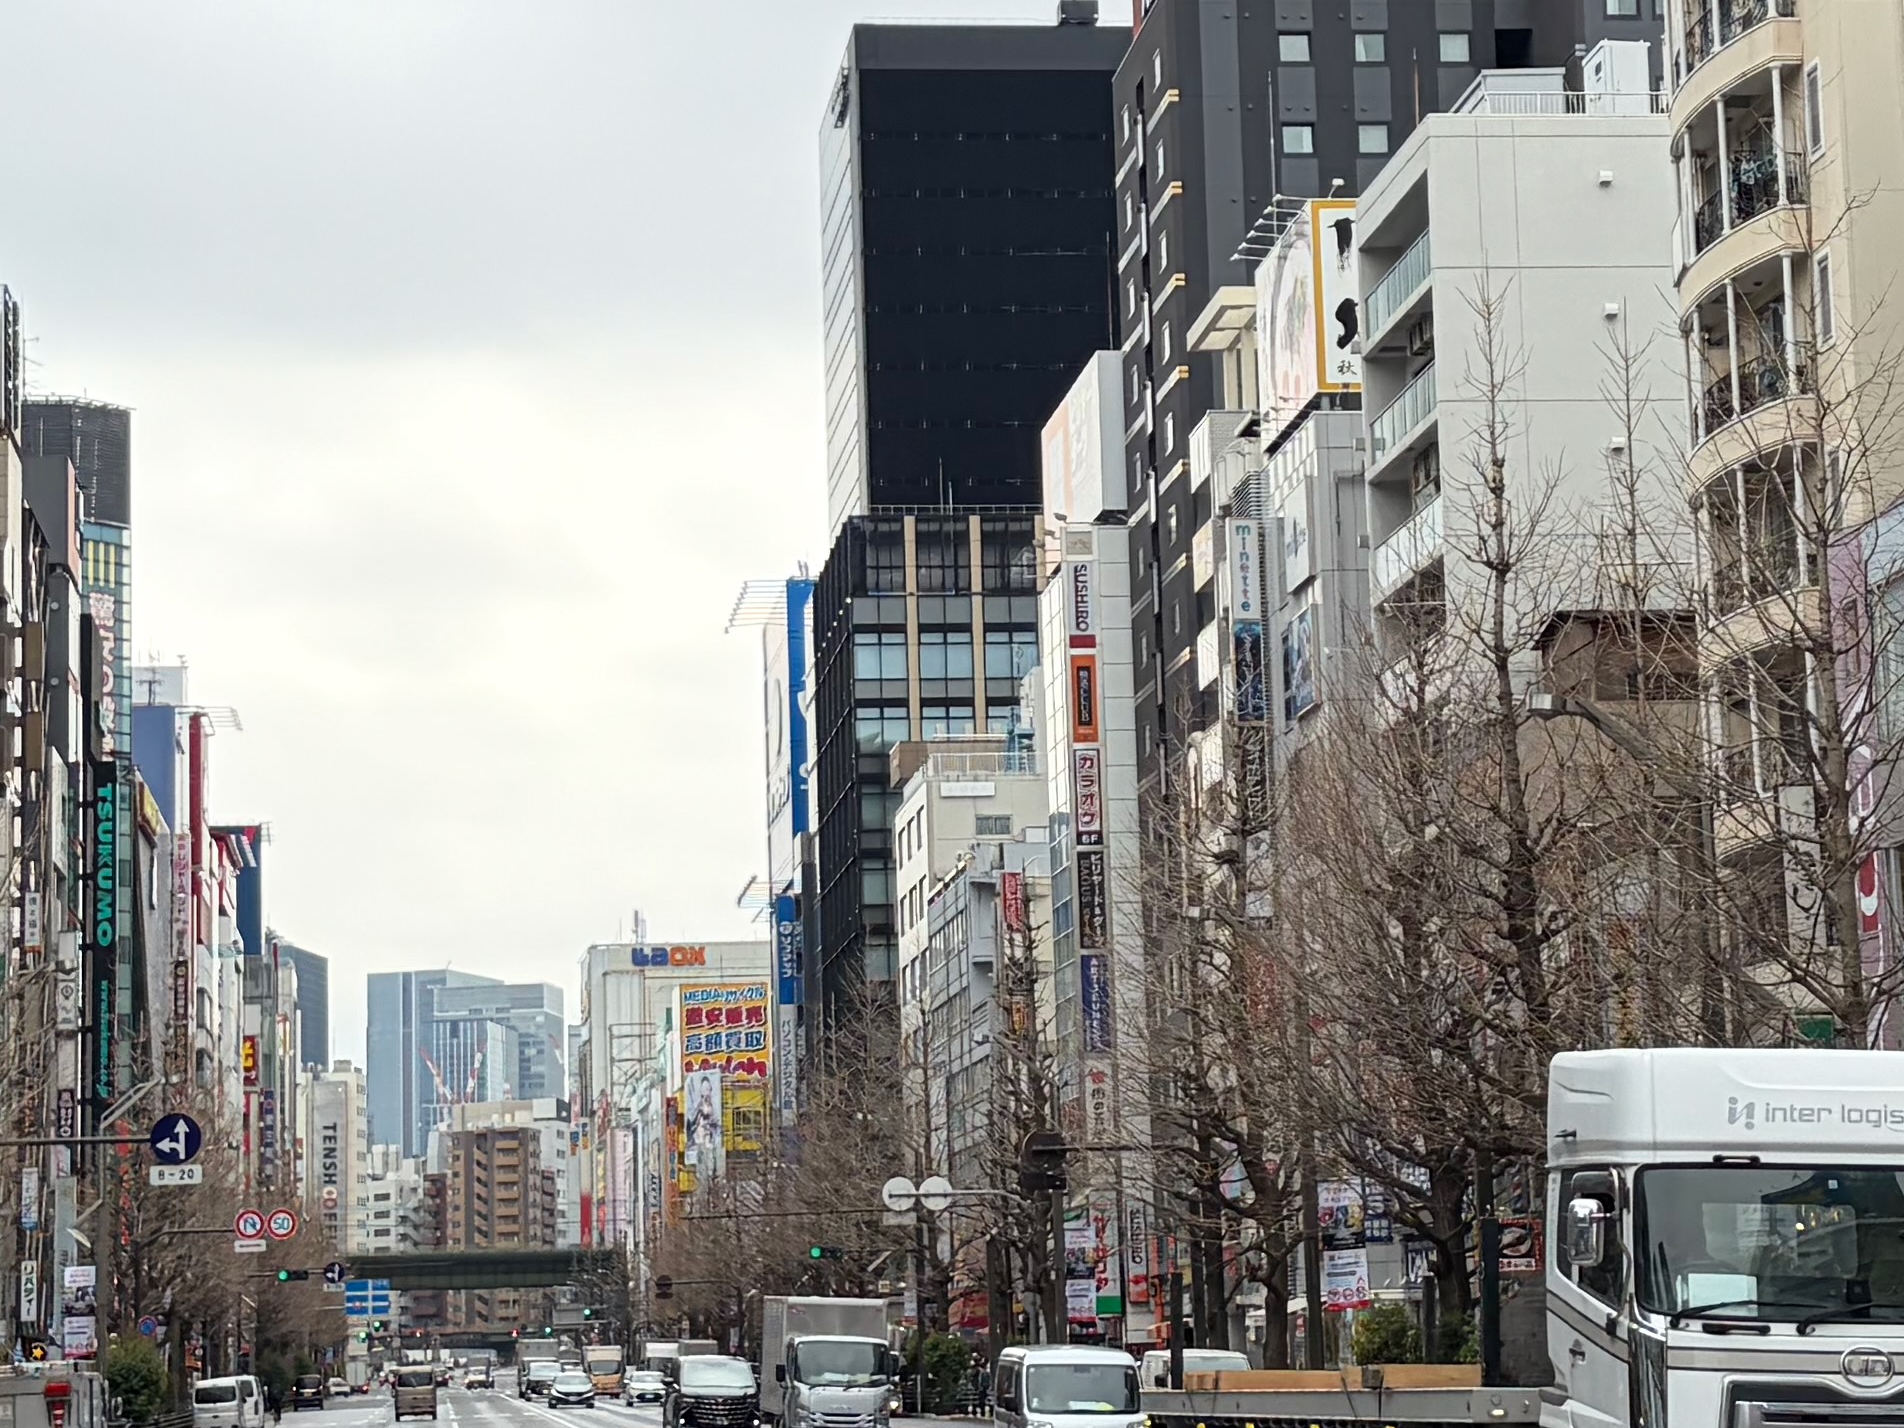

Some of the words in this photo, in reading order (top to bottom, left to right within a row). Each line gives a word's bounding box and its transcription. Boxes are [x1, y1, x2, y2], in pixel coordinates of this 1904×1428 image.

[1075, 564, 1088, 633] SUSHIRO
[1235, 524, 1251, 613] minette
[96, 783, 113, 948] TSUKUMO
[1764, 1102, 1832, 1125] inter
[273, 1218, 290, 1231] 50
